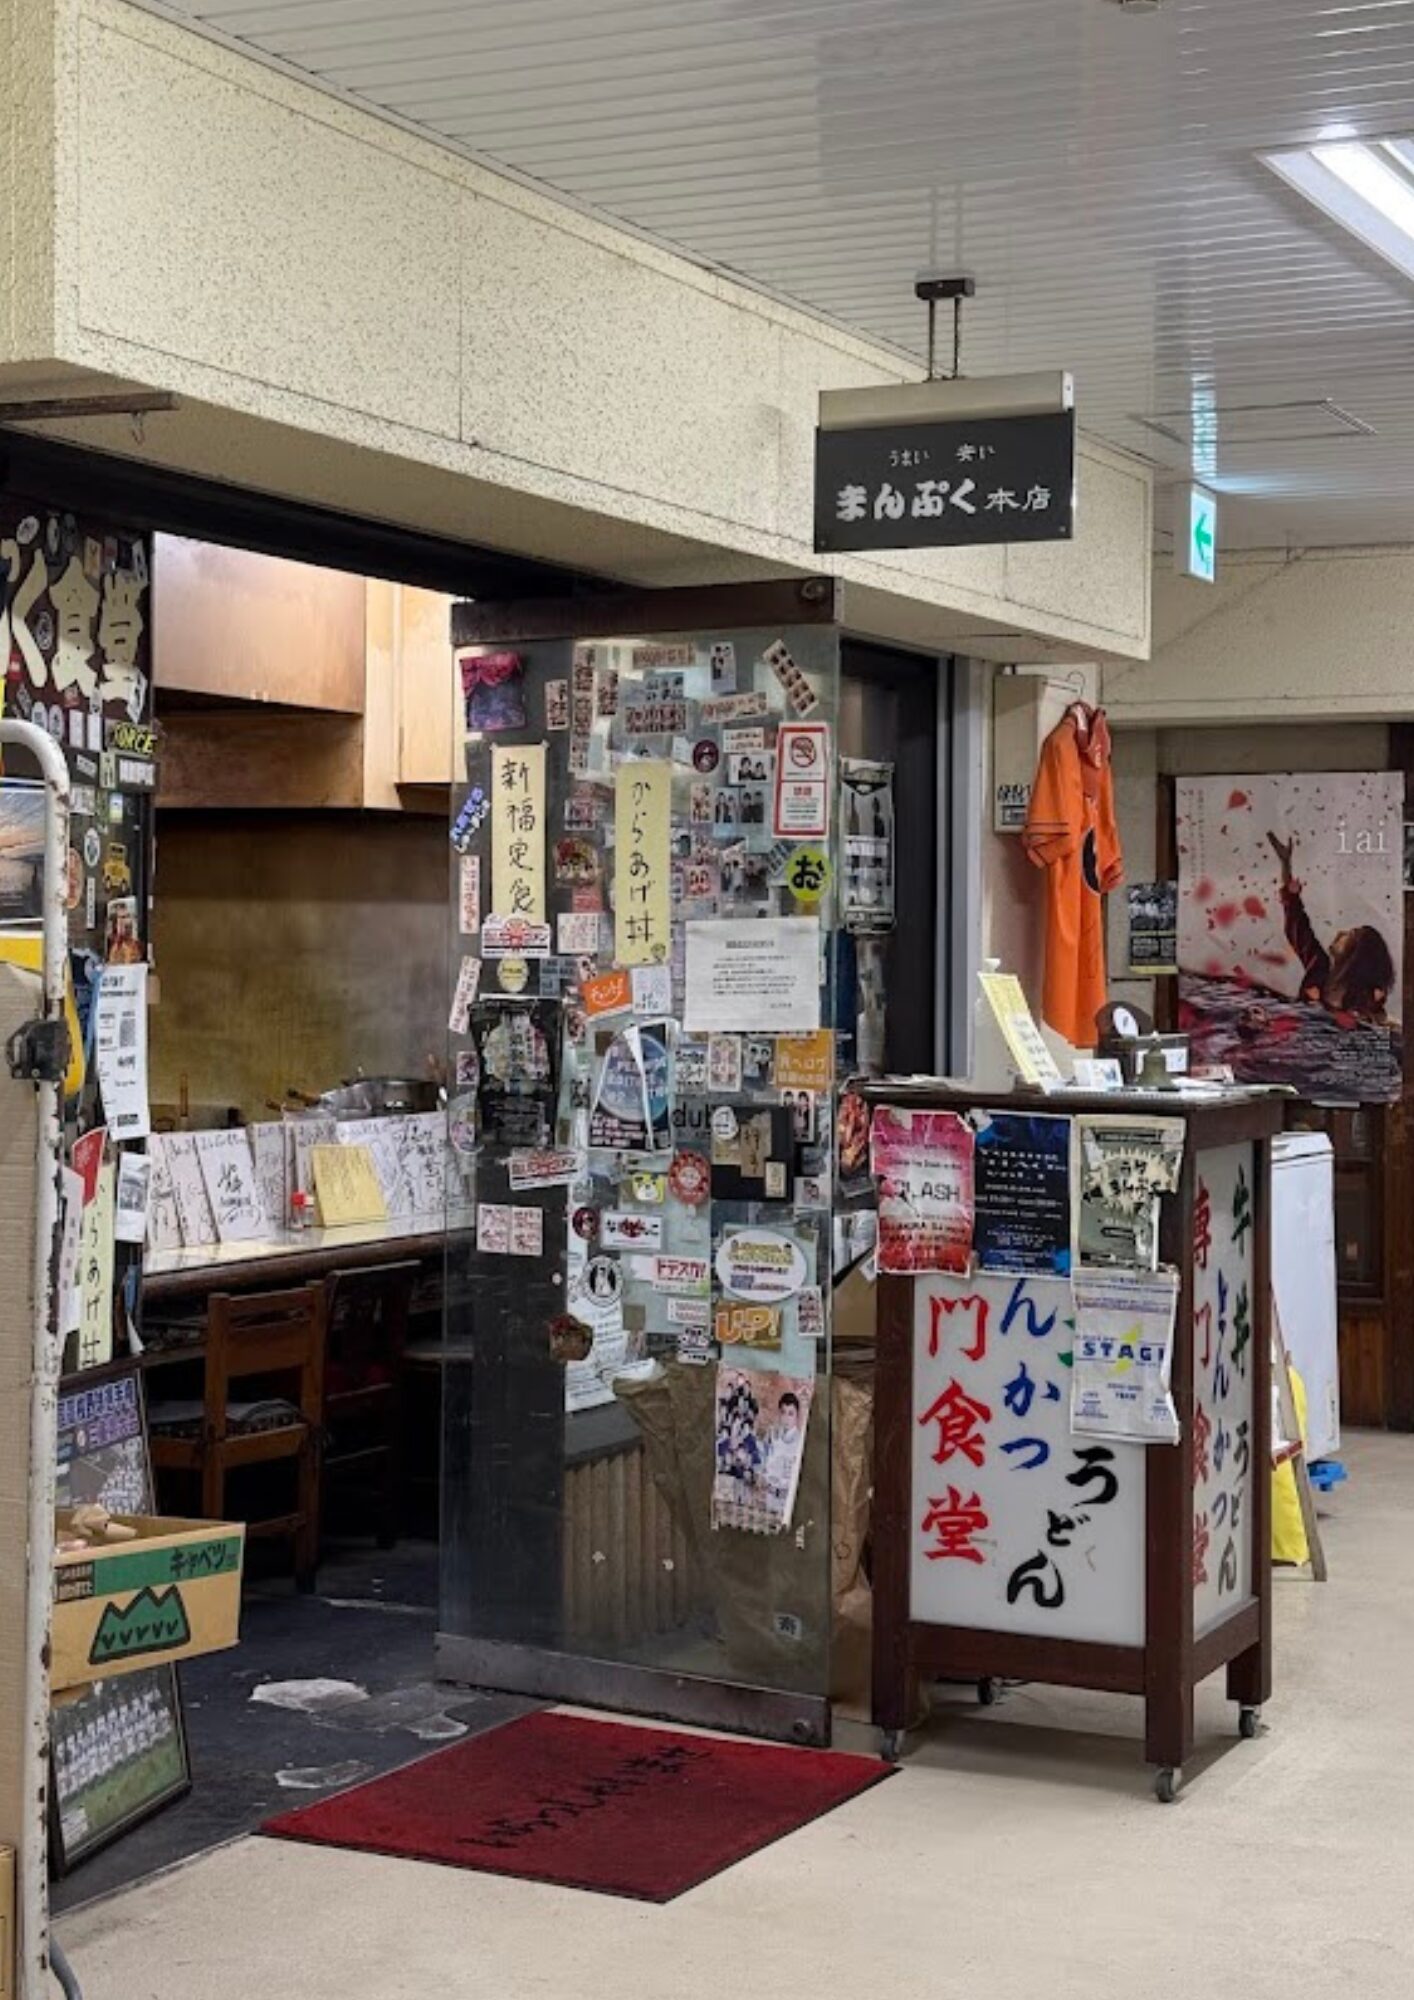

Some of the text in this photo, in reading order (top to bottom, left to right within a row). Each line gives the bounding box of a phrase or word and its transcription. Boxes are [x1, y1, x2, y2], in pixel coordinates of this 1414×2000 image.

[889, 442, 996, 467] うまい 安い
[625, 781, 656, 944] からあげ丼
[791, 855, 825, 892] お
[1336, 820, 1389, 853] iai
[1212, 1268, 1231, 1527] とんかつ
[1006, 1446, 1119, 1608] うどん
[1218, 1419, 1251, 1596] うどん
[170, 1542, 227, 1577] キャベツ
